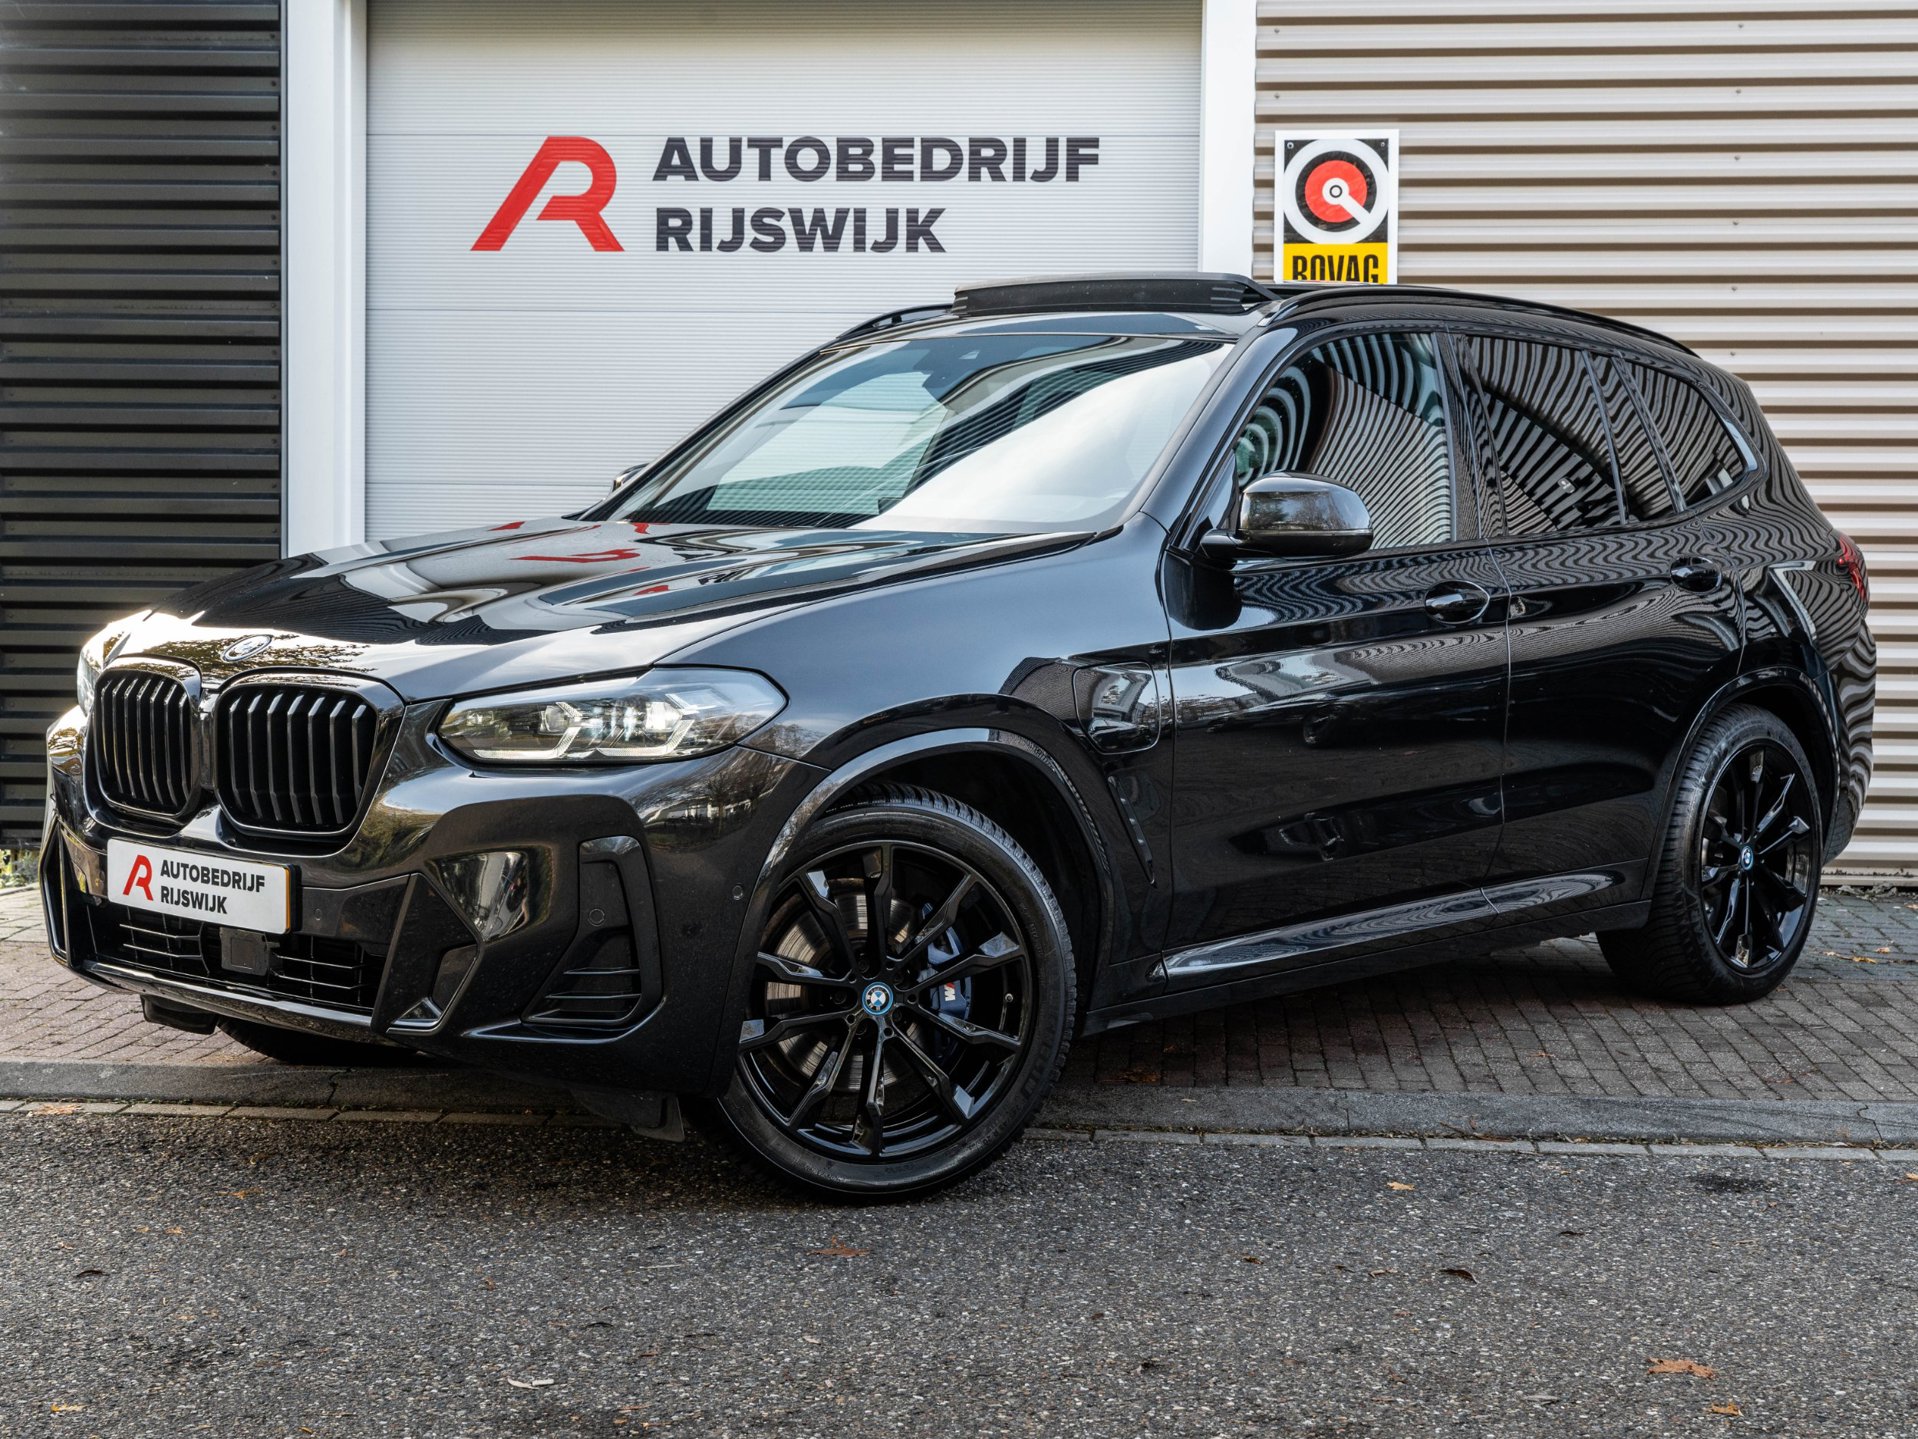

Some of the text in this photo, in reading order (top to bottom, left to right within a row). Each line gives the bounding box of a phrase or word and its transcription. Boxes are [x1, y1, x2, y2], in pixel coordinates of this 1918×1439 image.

[653, 136, 1100, 183] AUTOBEDRIJF
[656, 207, 946, 252] RIJSWIJK
[1292, 254, 1379, 283] BOVAG
[160, 861, 265, 892] AUTOBEDRIJF
[161, 886, 227, 914] RIJSWIJK
